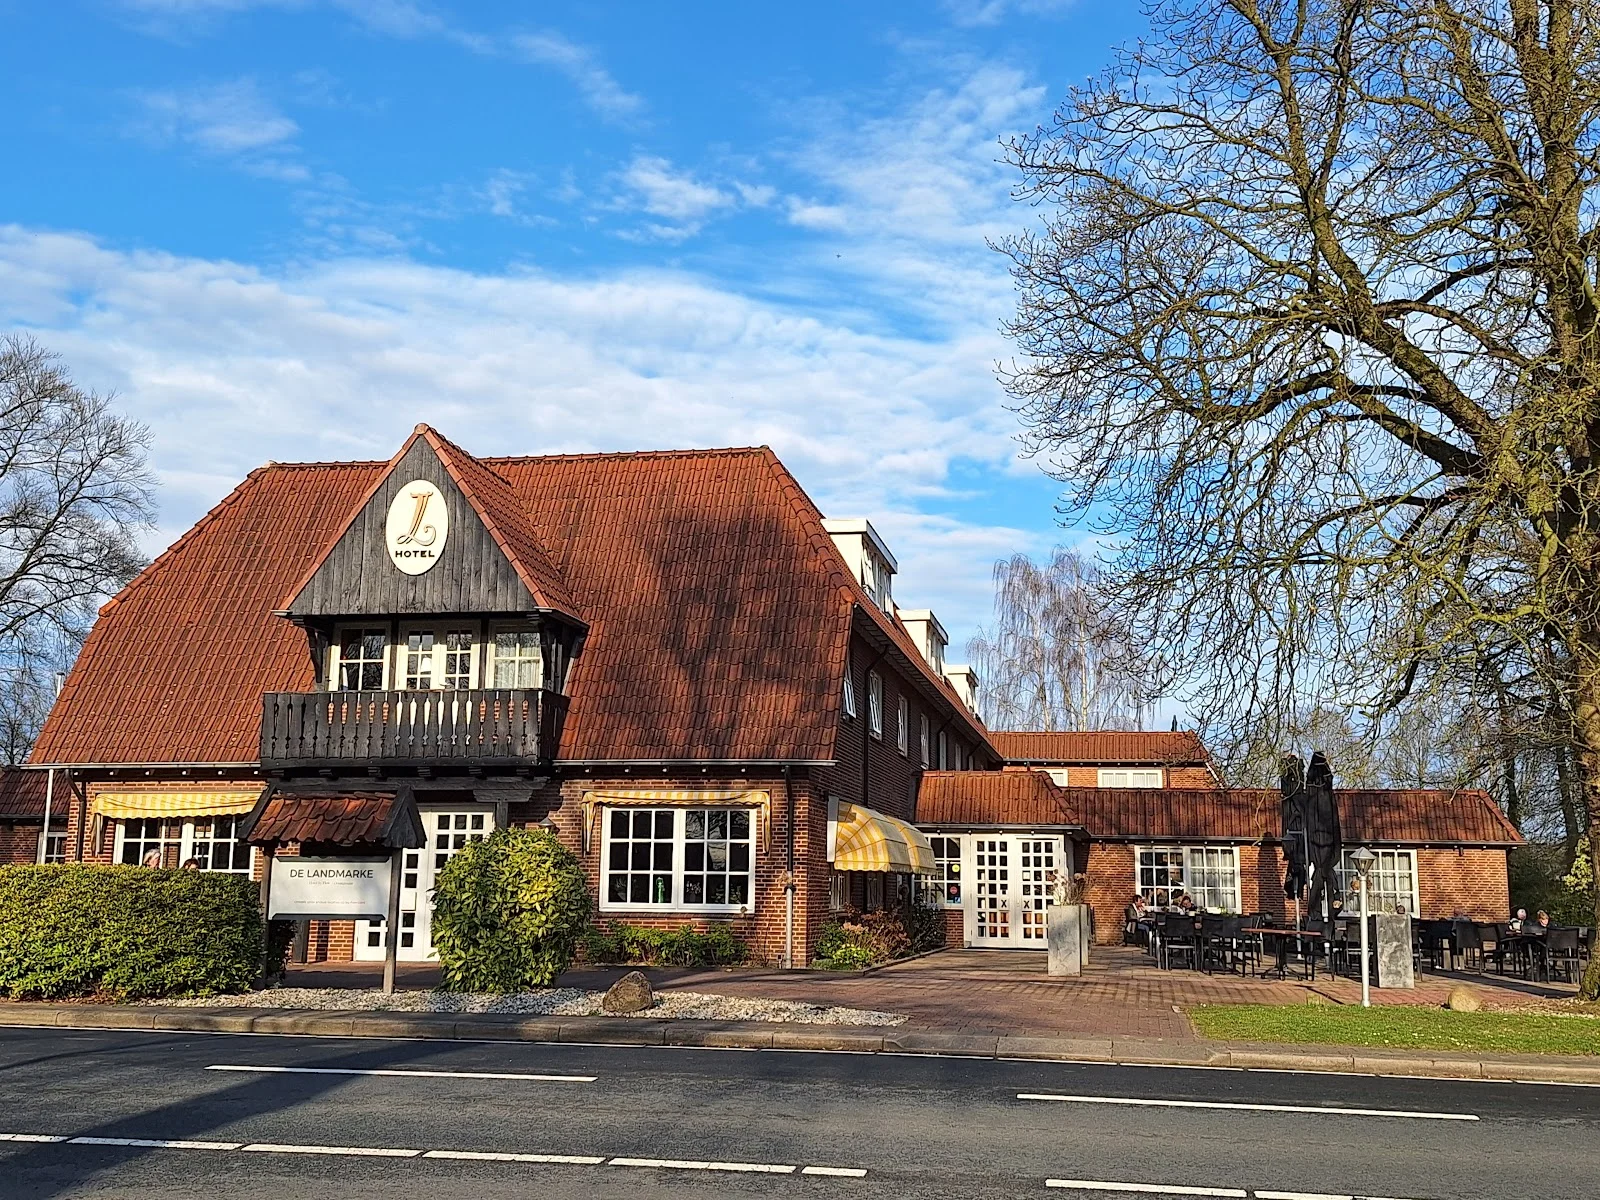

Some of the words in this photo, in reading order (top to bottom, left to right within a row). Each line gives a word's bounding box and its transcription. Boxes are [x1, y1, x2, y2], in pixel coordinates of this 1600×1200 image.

[395, 550, 435, 558] HOTEL
[290, 869, 304, 878] DE
[307, 869, 374, 879] LANDMARKE
